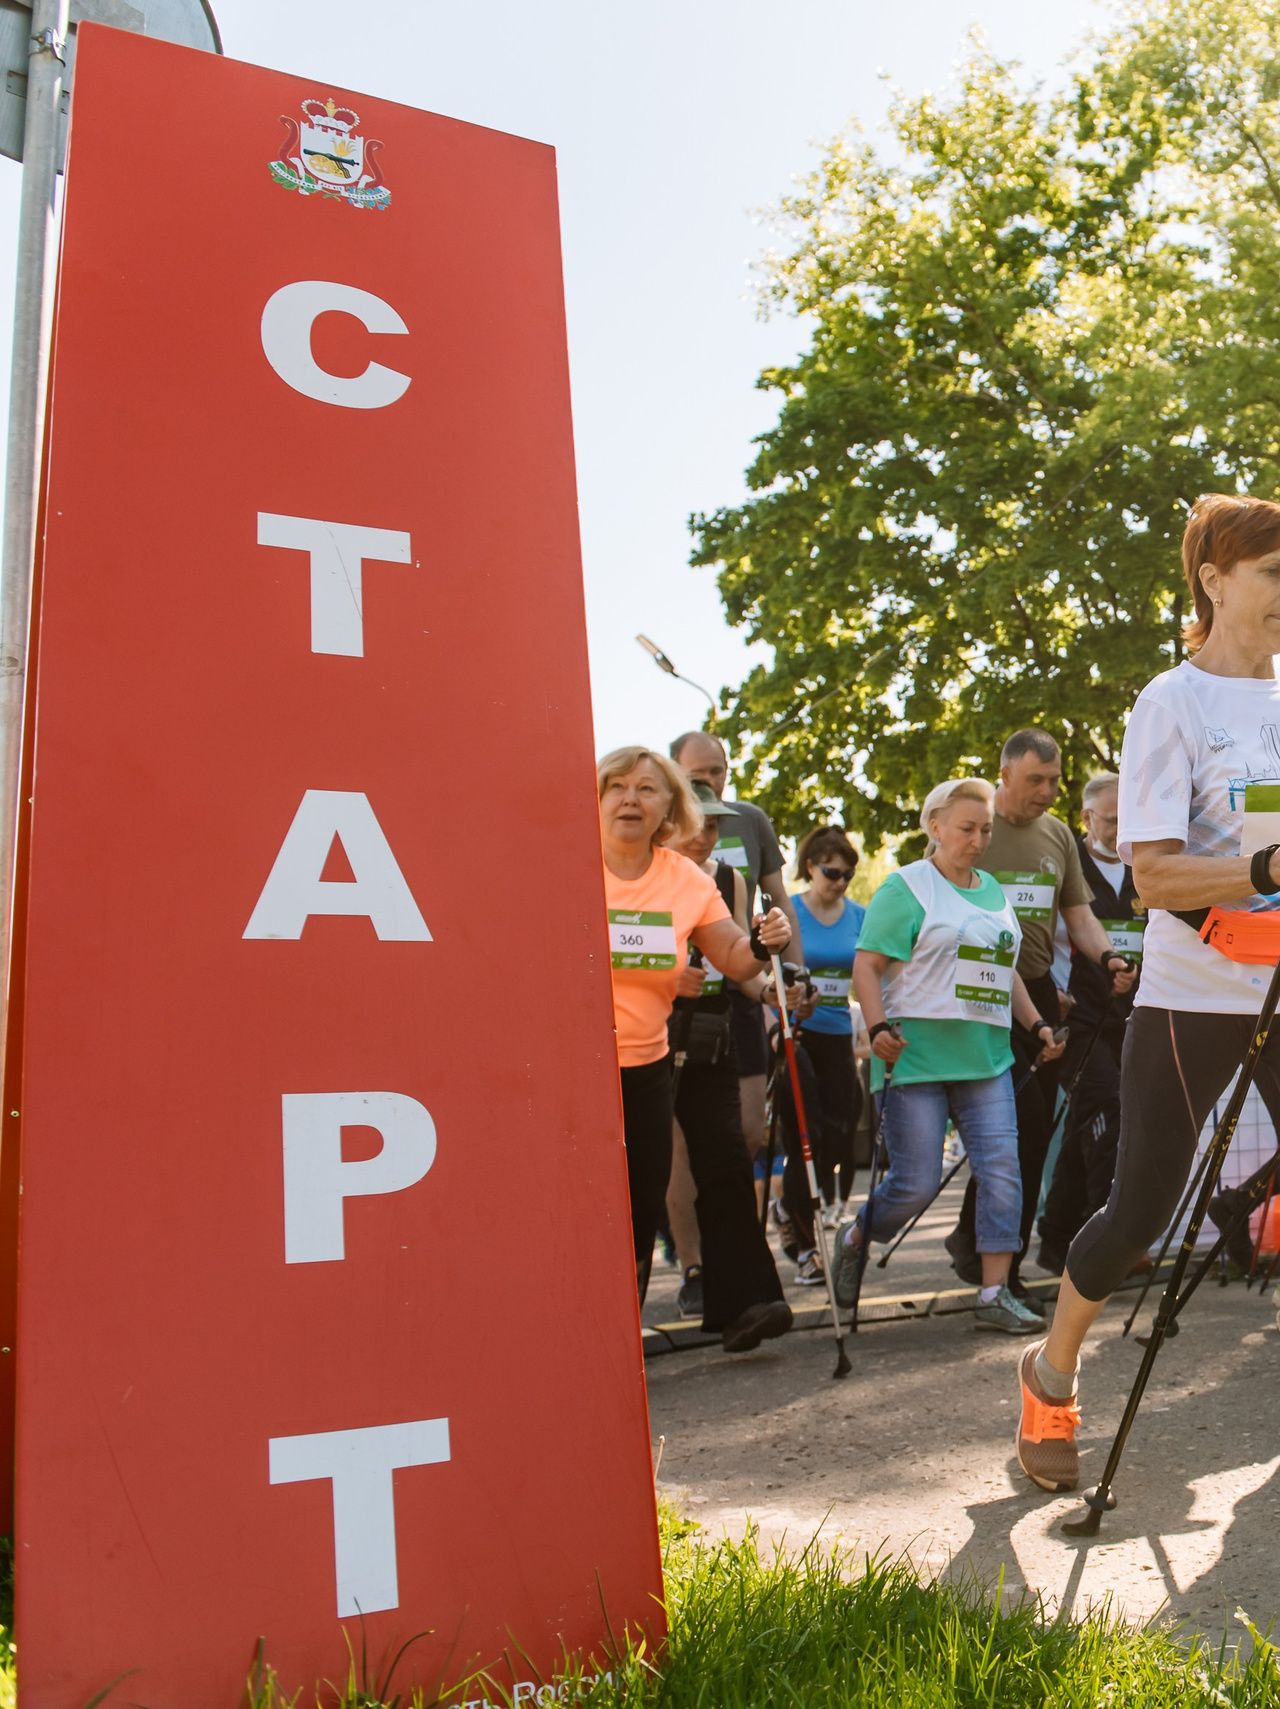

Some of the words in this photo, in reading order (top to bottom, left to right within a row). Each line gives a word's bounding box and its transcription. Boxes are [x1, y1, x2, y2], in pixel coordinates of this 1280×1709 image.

[1017, 892, 1035, 902] 276
[619, 934, 644, 946] 360
[1112, 938, 1128, 947] 254
[241, 280, 451, 1618] СТАРТ
[980, 971, 996, 983] 110
